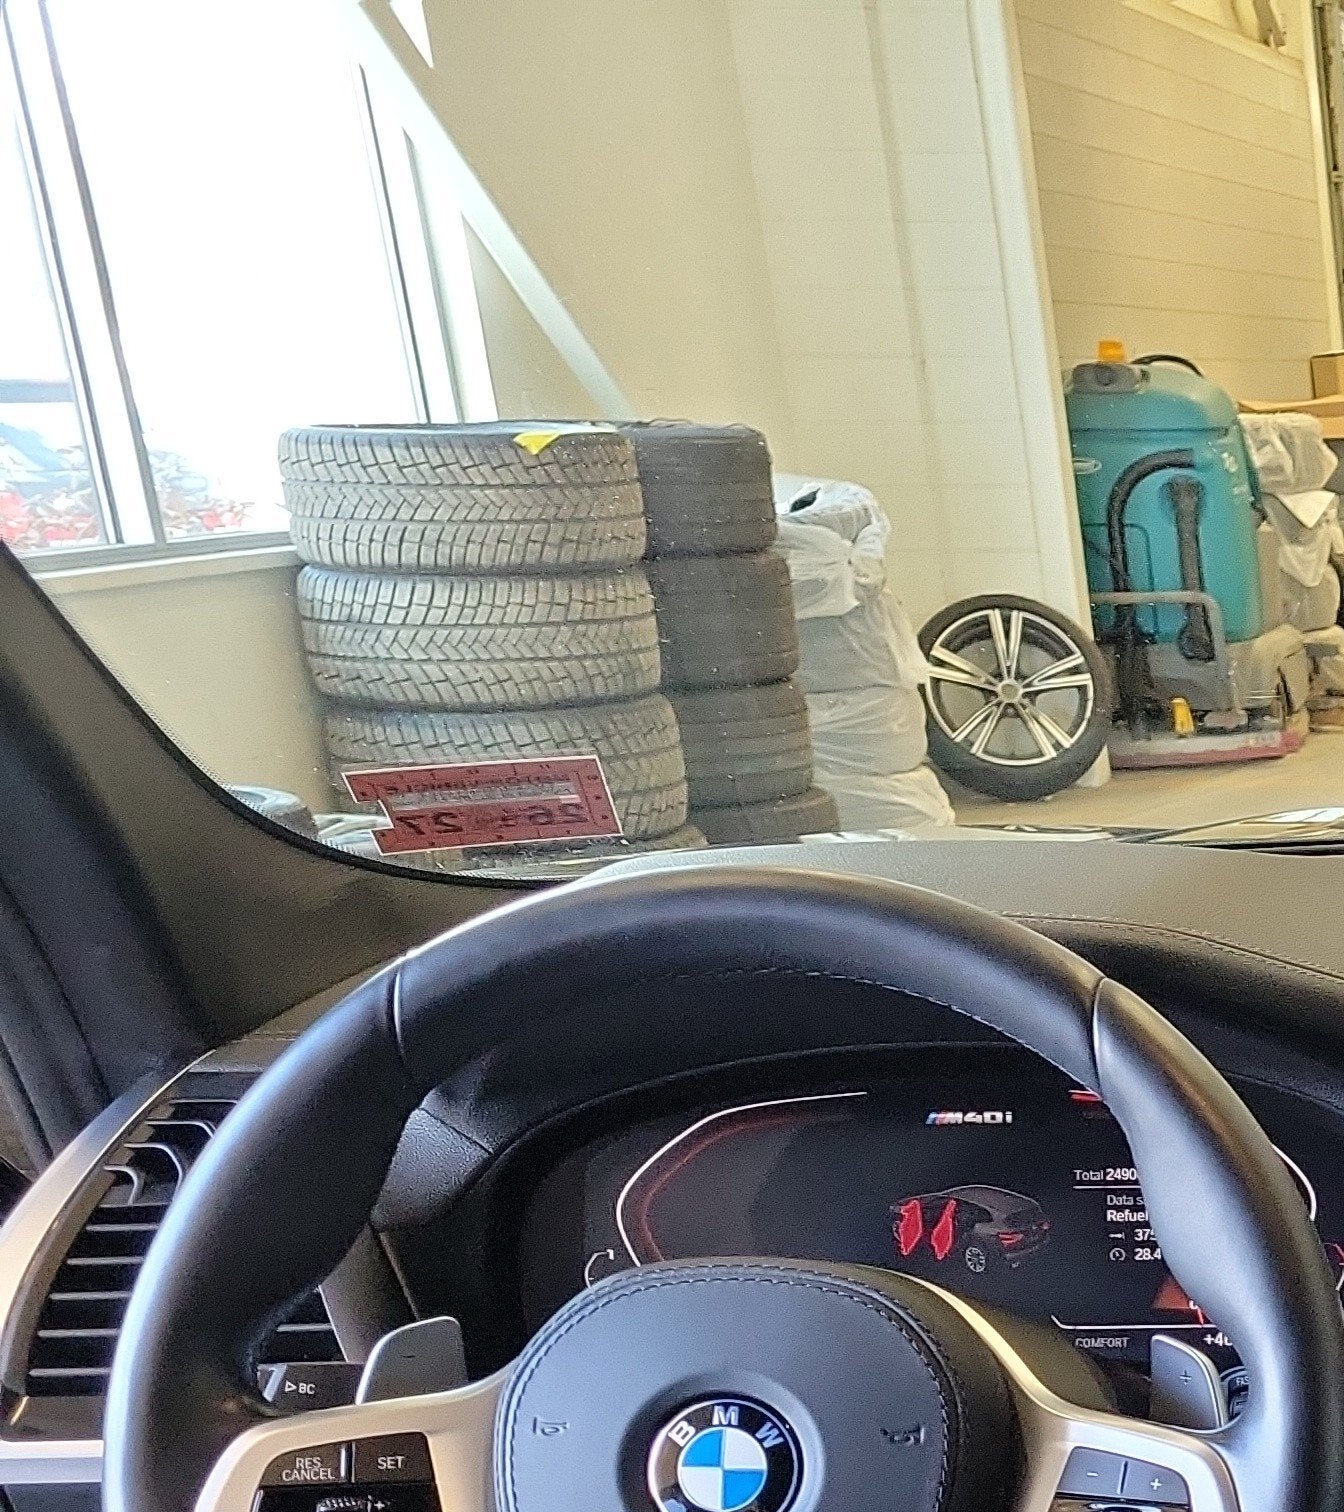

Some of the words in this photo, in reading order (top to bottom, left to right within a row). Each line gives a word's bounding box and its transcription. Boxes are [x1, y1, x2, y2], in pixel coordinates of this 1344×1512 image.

[1073, 1168, 1104, 1182] Total
[1106, 1193, 1134, 1207] Data
[1133, 1247, 1162, 1260] 28.4
[299, 1383, 316, 1395] BC
[667, 1405, 785, 1449] BMW
[295, 1456, 323, 1469] RES
[377, 1455, 406, 1470] SET
[281, 1467, 336, 1482] CANCEL
